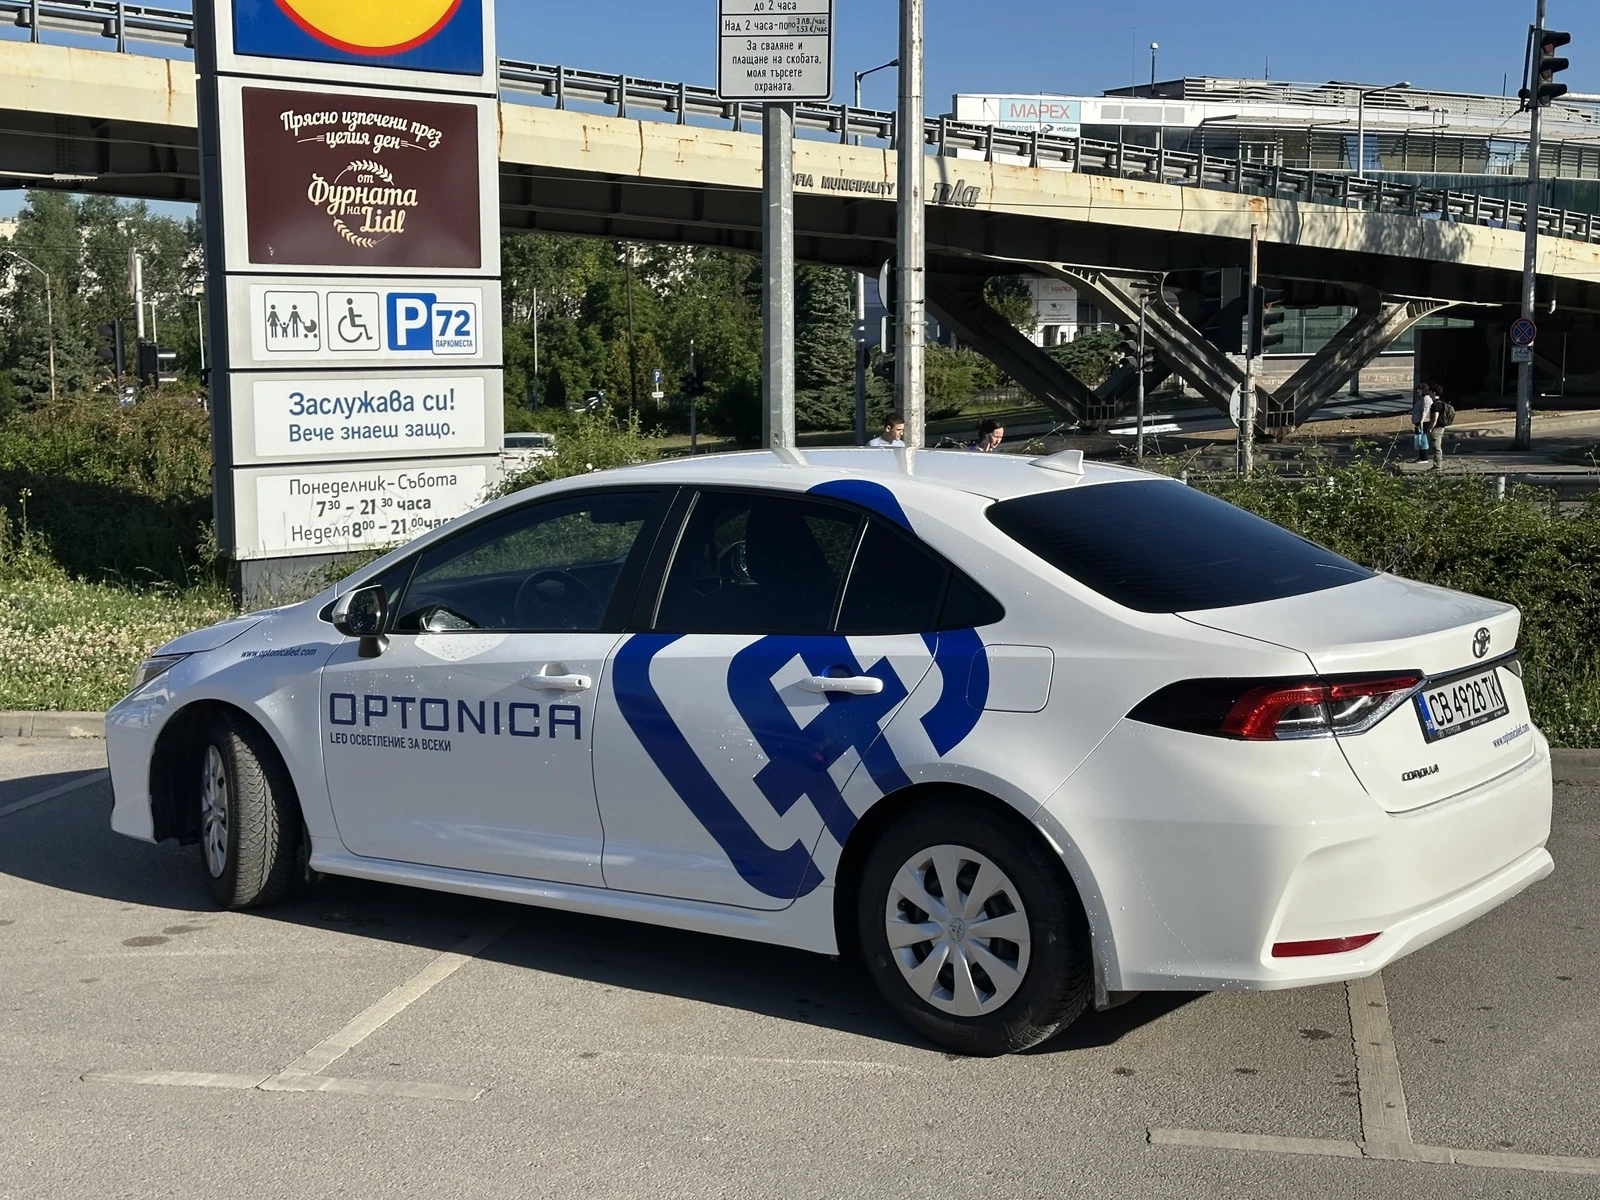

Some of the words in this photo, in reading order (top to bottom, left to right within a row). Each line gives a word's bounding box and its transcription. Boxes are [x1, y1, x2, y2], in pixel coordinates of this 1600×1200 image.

[754, 2, 764, 11] до
[768, 0, 774, 10] 2
[778, 2, 796, 10] часа
[725, 20, 741, 31] Над
[746, 20, 750, 30] 2
[746, 40, 756, 50] За
[761, 42, 794, 50] сваляне
[798, 42, 802, 50] и
[732, 56, 768, 65] плащане
[772, 56, 782, 64] на
[786, 52, 822, 64] скобата,
[746, 69, 766, 78] моля
[770, 69, 802, 80] търсете
[754, 82, 794, 93] охраната.
[1010, 103, 1070, 119] MAPEX
[280, 110, 338, 136] Прясно
[342, 111, 408, 132] изпечени
[410, 122, 442, 148] през
[326, 131, 370, 148] целия
[373, 134, 400, 154] ден
[357, 174, 374, 184] от
[821, 176, 895, 195] MUNICIPALITY
[308, 173, 418, 215] Фурната
[932, 179, 981, 207] TRACE
[346, 206, 360, 214] на
[360, 206, 406, 233] Lidl
[396, 298, 428, 346] P
[436, 310, 470, 336] 72
[436, 340, 472, 348] ПАРКОМЕСТА
[288, 390, 414, 420] Заслужава
[422, 388, 454, 411] си!
[289, 424, 334, 442] Вече
[340, 424, 398, 440] знаеш
[405, 422, 456, 440] защо.
[397, 498, 431, 511] часа
[292, 525, 350, 544] Неделя
[240, 646, 317, 659] www.optonicaled.com
[1428, 692, 1454, 726] CB
[1452, 680, 1486, 718] 4928
[1480, 674, 1502, 708] TK
[330, 692, 582, 740] OPTONICA
[330, 732, 348, 744] LED
[350, 734, 406, 749] ОСВЕТЛЕНИЕ
[408, 738, 420, 750] ЗА
[422, 738, 452, 752] ВСЕКИ
[1402, 764, 1439, 782] COROLLA
